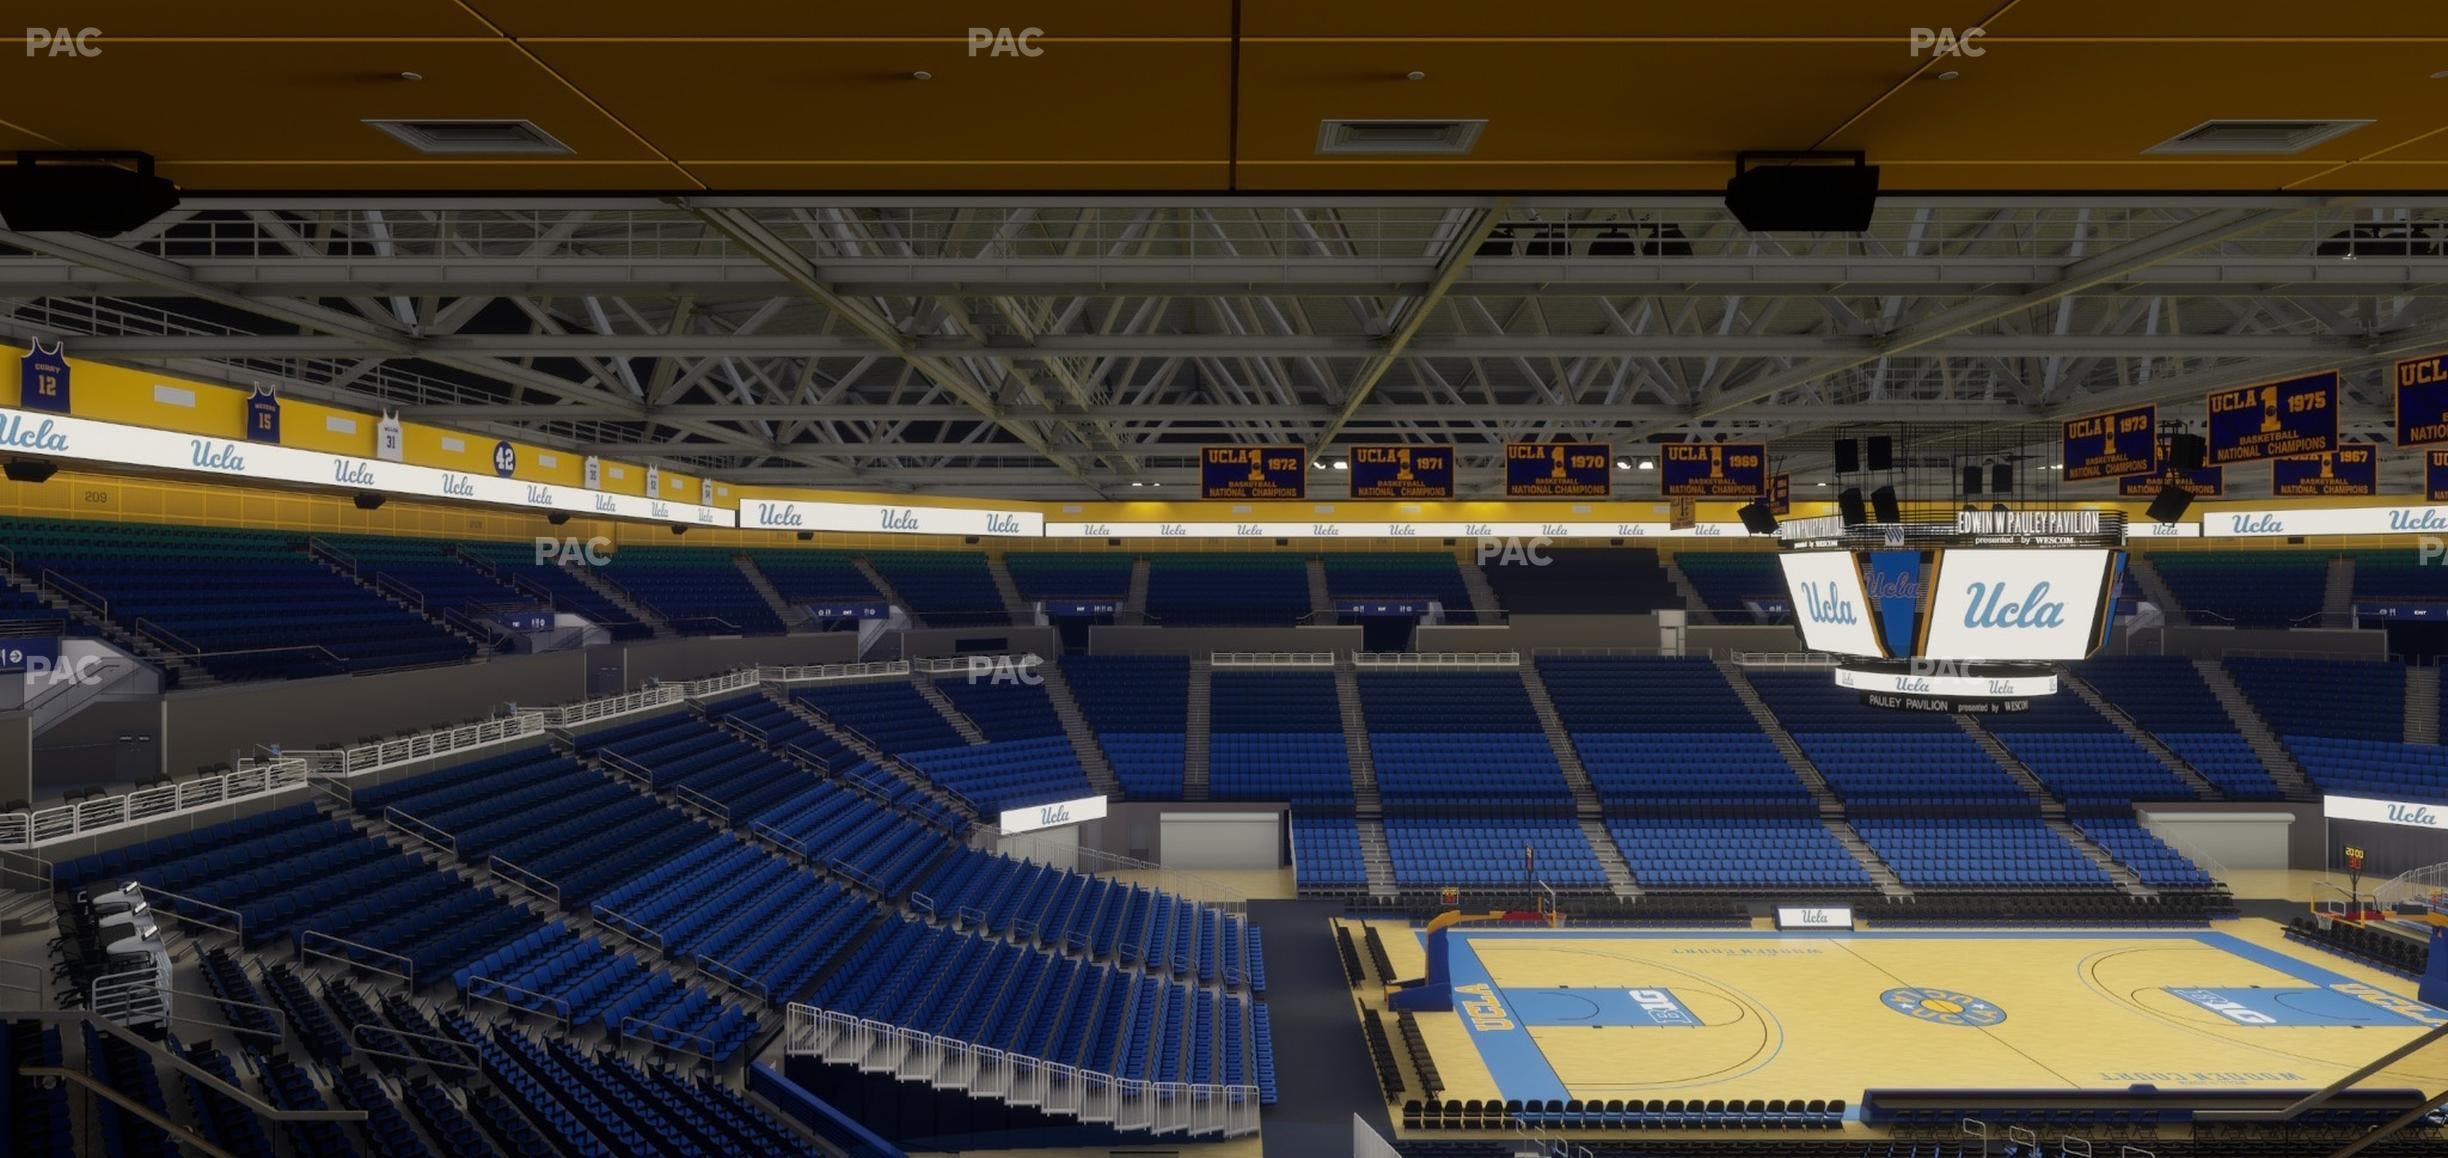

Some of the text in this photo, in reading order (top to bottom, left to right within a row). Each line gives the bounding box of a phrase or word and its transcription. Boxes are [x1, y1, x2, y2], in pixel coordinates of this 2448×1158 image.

[38, 375, 57, 396] 12
[2212, 386, 2327, 432] UCLA 1 1975
[259, 412, 272, 430] 15
[2069, 417, 2102, 439] UCLA
[2120, 414, 2148, 433] 1973
[386, 435, 396, 449] 31
[2239, 429, 2300, 445] BASKETBALL
[191, 439, 245, 471] Ucla
[495, 446, 514, 470] 42
[1508, 446, 1546, 459] UCLA
[1570, 455, 1605, 468] 1970
[1668, 446, 1708, 460] UCLA
[1729, 455, 1758, 468] 1969
[2217, 436, 2327, 461] NATIONAL CHAMPIONS
[1208, 449, 1248, 463] UCLA
[1268, 458, 1297, 470] 1972
[1357, 448, 1396, 462] UCLA
[1417, 457, 1443, 470] 1971
[2085, 453, 2130, 466] BASKETBALL
[334, 458, 375, 486] Ucla
[2069, 459, 2148, 479] NATIONAL CHAMPIONS
[441, 473, 475, 497] Ucla
[1209, 488, 1297, 498] NATIONAL CHAMPIONS
[1228, 480, 1278, 488] BASKETBALL
[1358, 487, 1446, 497] NATIONAL CHAMPIONS
[1511, 485, 1605, 494] NATIONAL CHAMPIONS
[1669, 485, 1757, 494] NATIONAL CHAMPIONS
[2127, 485, 2163, 494] NATIONA
[2281, 485, 2368, 494] NATIONAL CHAMPIONS
[84, 490, 108, 503] 209
[526, 484, 553, 505] Ucla
[758, 503, 803, 527] Ucla
[879, 508, 920, 531] Ucla
[985, 512, 1020, 534] Ucla
[1958, 511, 2100, 534] EDWIN W PAULEY PAVILION
[2231, 513, 2284, 533] Ucla
[2388, 509, 2448, 530] Ucla
[1084, 524, 1110, 536] Ucla
[1160, 524, 1186, 536] Ucla
[1237, 524, 1263, 536] Ucla
[1313, 524, 1339, 536] Ucla
[1390, 524, 1416, 536] Ucla
[1466, 524, 1492, 536] Ucla
[1542, 524, 1568, 536] Ucla
[1618, 524, 1644, 536] Ucla
[1695, 524, 1721, 536] Ucla
[1975, 536, 2014, 545] presented
[2021, 535, 2031, 545] by
[1801, 581, 1857, 626] Ucla
[1964, 581, 2064, 628] Ucla
[1895, 676, 1930, 692] Ucla
[1988, 680, 2014, 694] Ucla
[1869, 694, 1901, 708] PAULEY
[1905, 698, 1948, 711] PAVILION
[1957, 702, 1988, 712] presented
[1991, 702, 1999, 714] by
[1040, 804, 1070, 826] Ucla
[2387, 803, 2437, 825] Ucla
[1800, 909, 1829, 924] Ucla
